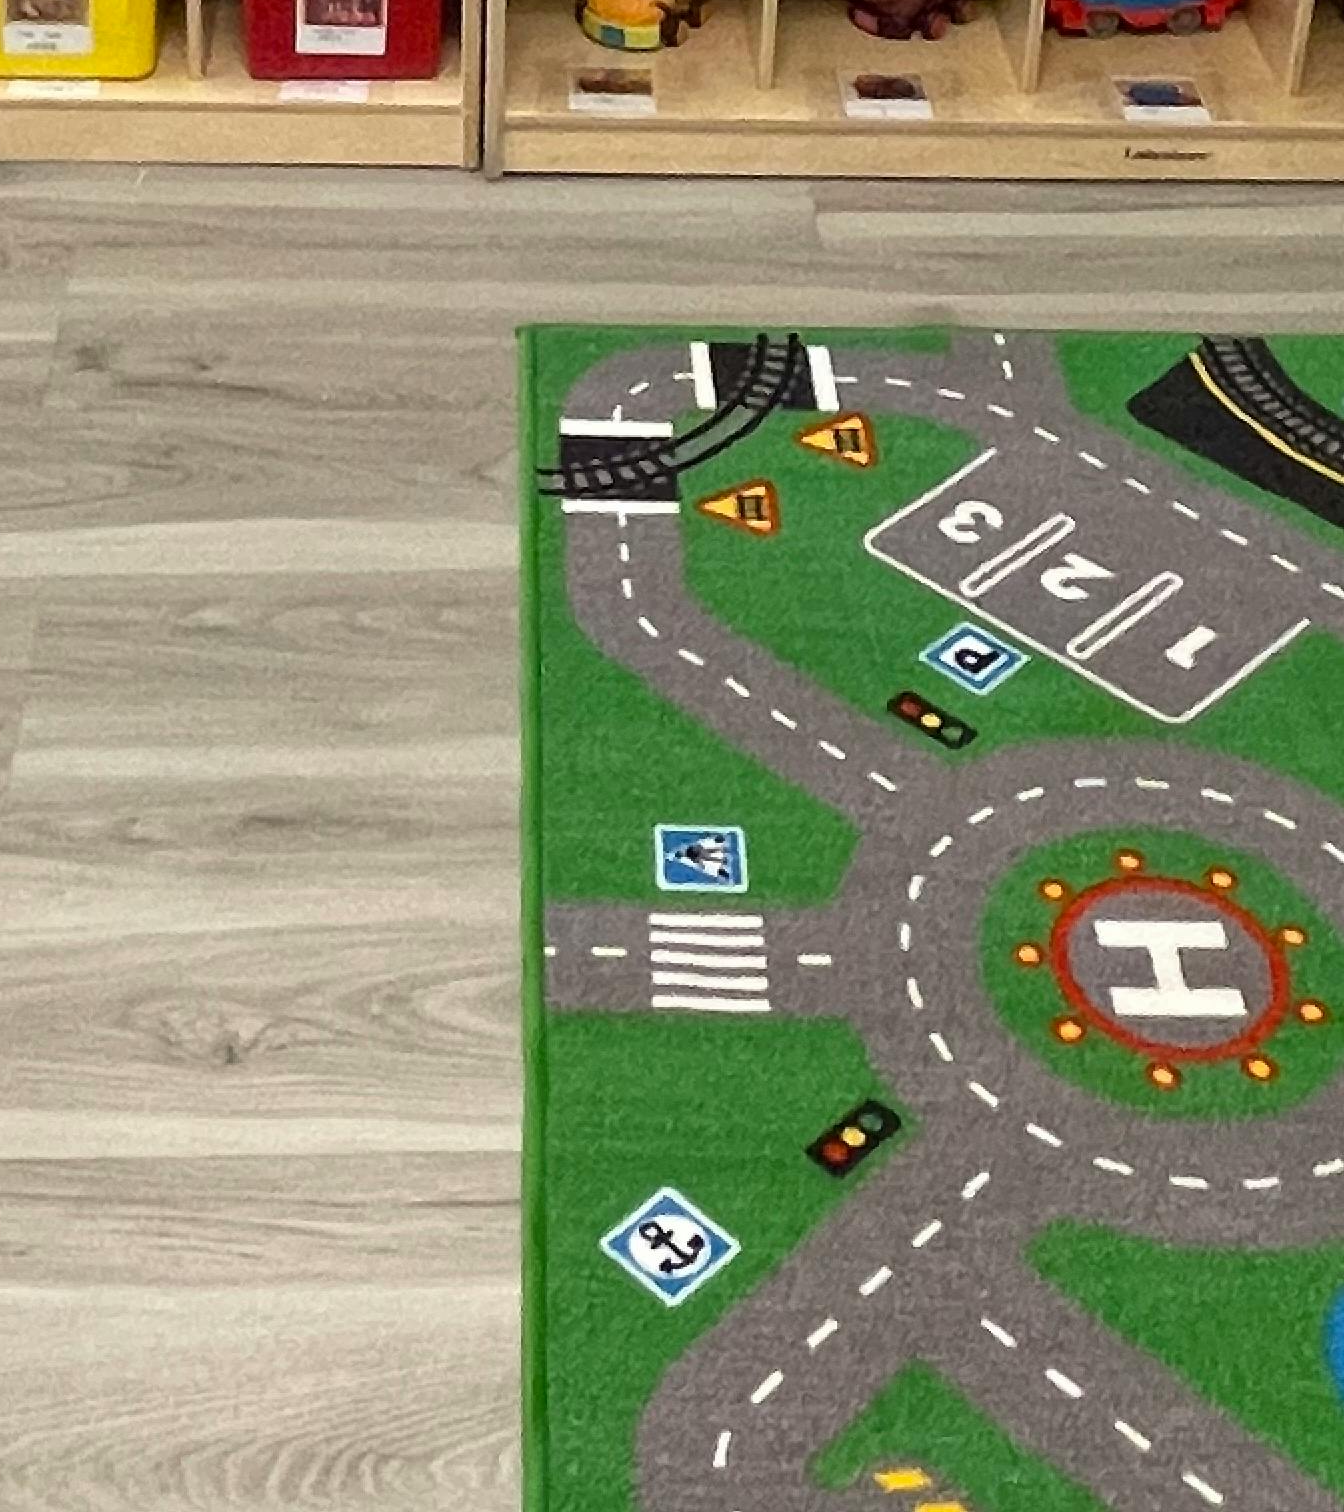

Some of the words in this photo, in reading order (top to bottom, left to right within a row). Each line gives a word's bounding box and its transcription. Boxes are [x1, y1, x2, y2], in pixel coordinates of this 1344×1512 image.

[938, 500, 1004, 543] 3
[1040, 552, 1116, 600] 2
[1165, 626, 1219, 670] 1
[1094, 920, 1247, 1016] H
